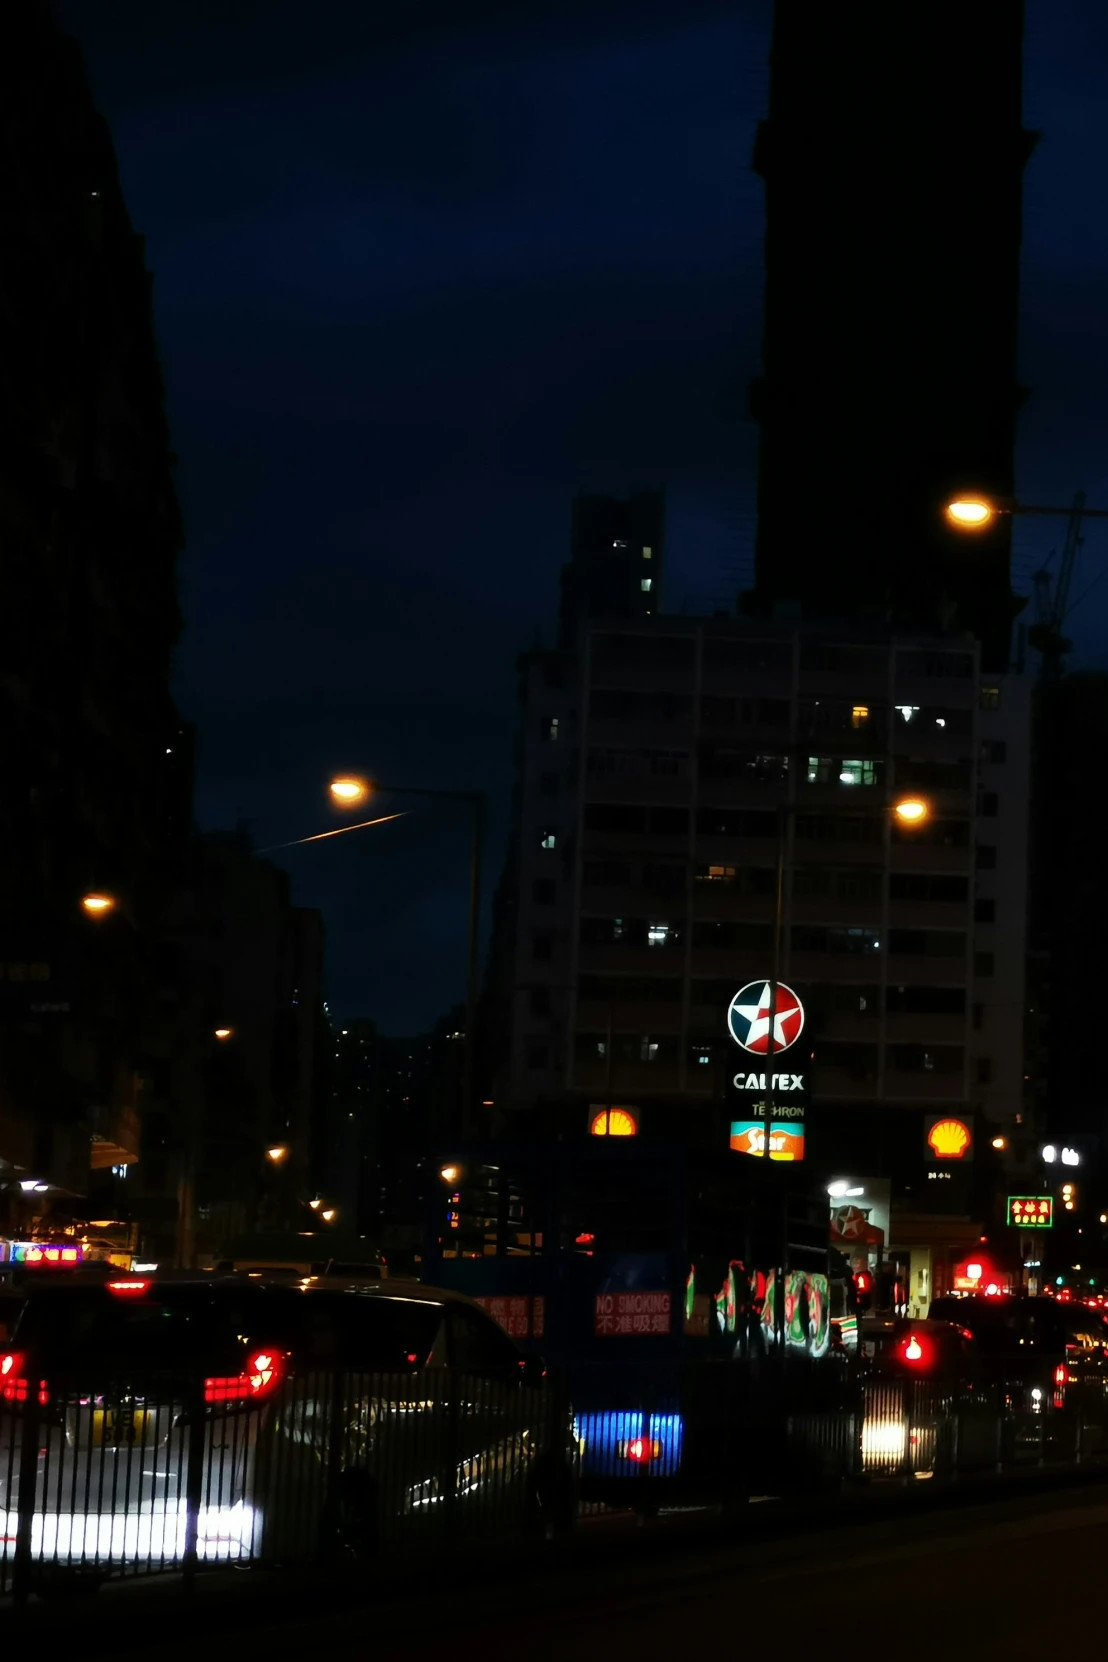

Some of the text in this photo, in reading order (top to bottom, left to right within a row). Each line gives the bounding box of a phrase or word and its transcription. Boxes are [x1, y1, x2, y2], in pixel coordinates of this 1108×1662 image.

[733, 1072, 805, 1091] CALTEX
[752, 1103, 805, 1118] TEHRON
[596, 1294, 671, 1314] NO SMOKING
